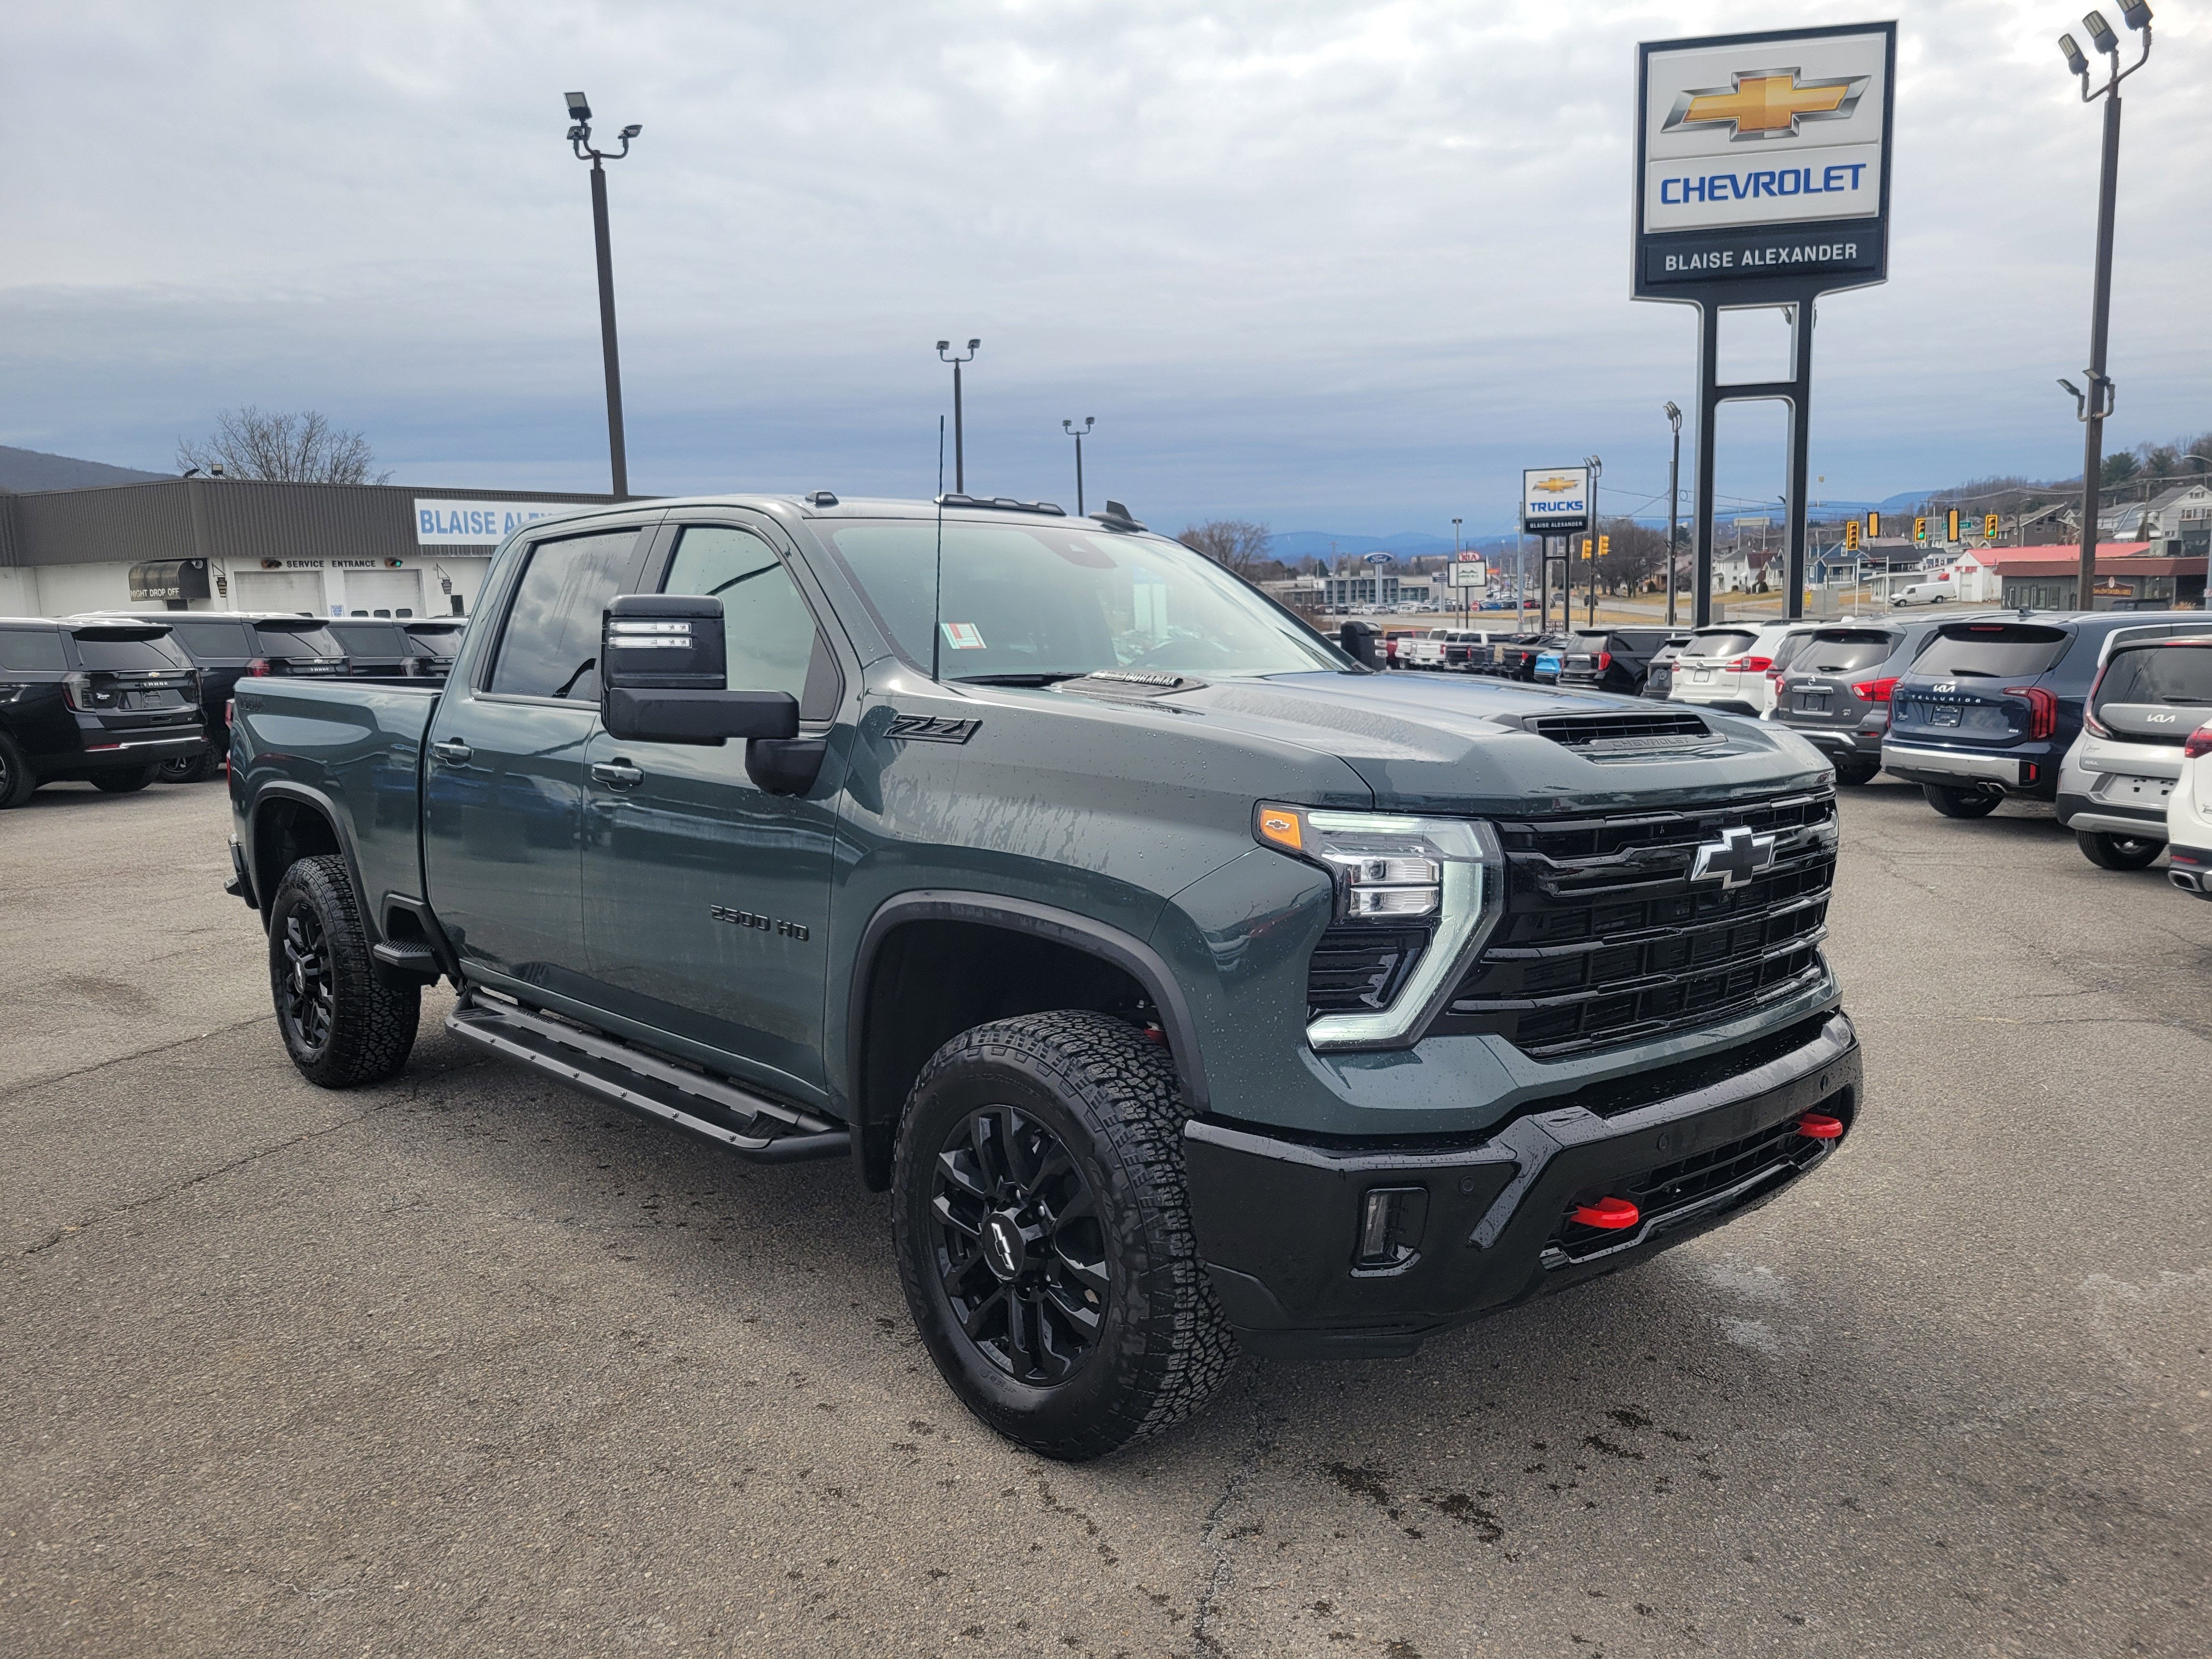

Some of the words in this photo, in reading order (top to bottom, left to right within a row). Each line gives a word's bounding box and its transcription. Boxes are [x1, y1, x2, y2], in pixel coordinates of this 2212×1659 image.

[1661, 163, 1866, 205] CHEVROLET
[1665, 251, 1733, 271] BLAISE
[1741, 243, 1857, 266] ALEXANDER
[1530, 500, 1583, 512] TRUCKS
[420, 510, 497, 535] BLAISE
[286, 560, 325, 568] SERVICE
[331, 560, 376, 568] ENTRANCE
[131, 589, 148, 597] NIGHT
[149, 589, 166, 597] DROP
[167, 588, 179, 596] OFF
[1125, 673, 1180, 687] DURAMAX
[1911, 694, 1981, 703] TELLURIDE
[1609, 737, 1690, 748] CHEVROLET
[711, 905, 771, 932] 2500
[776, 919, 809, 941] HD
